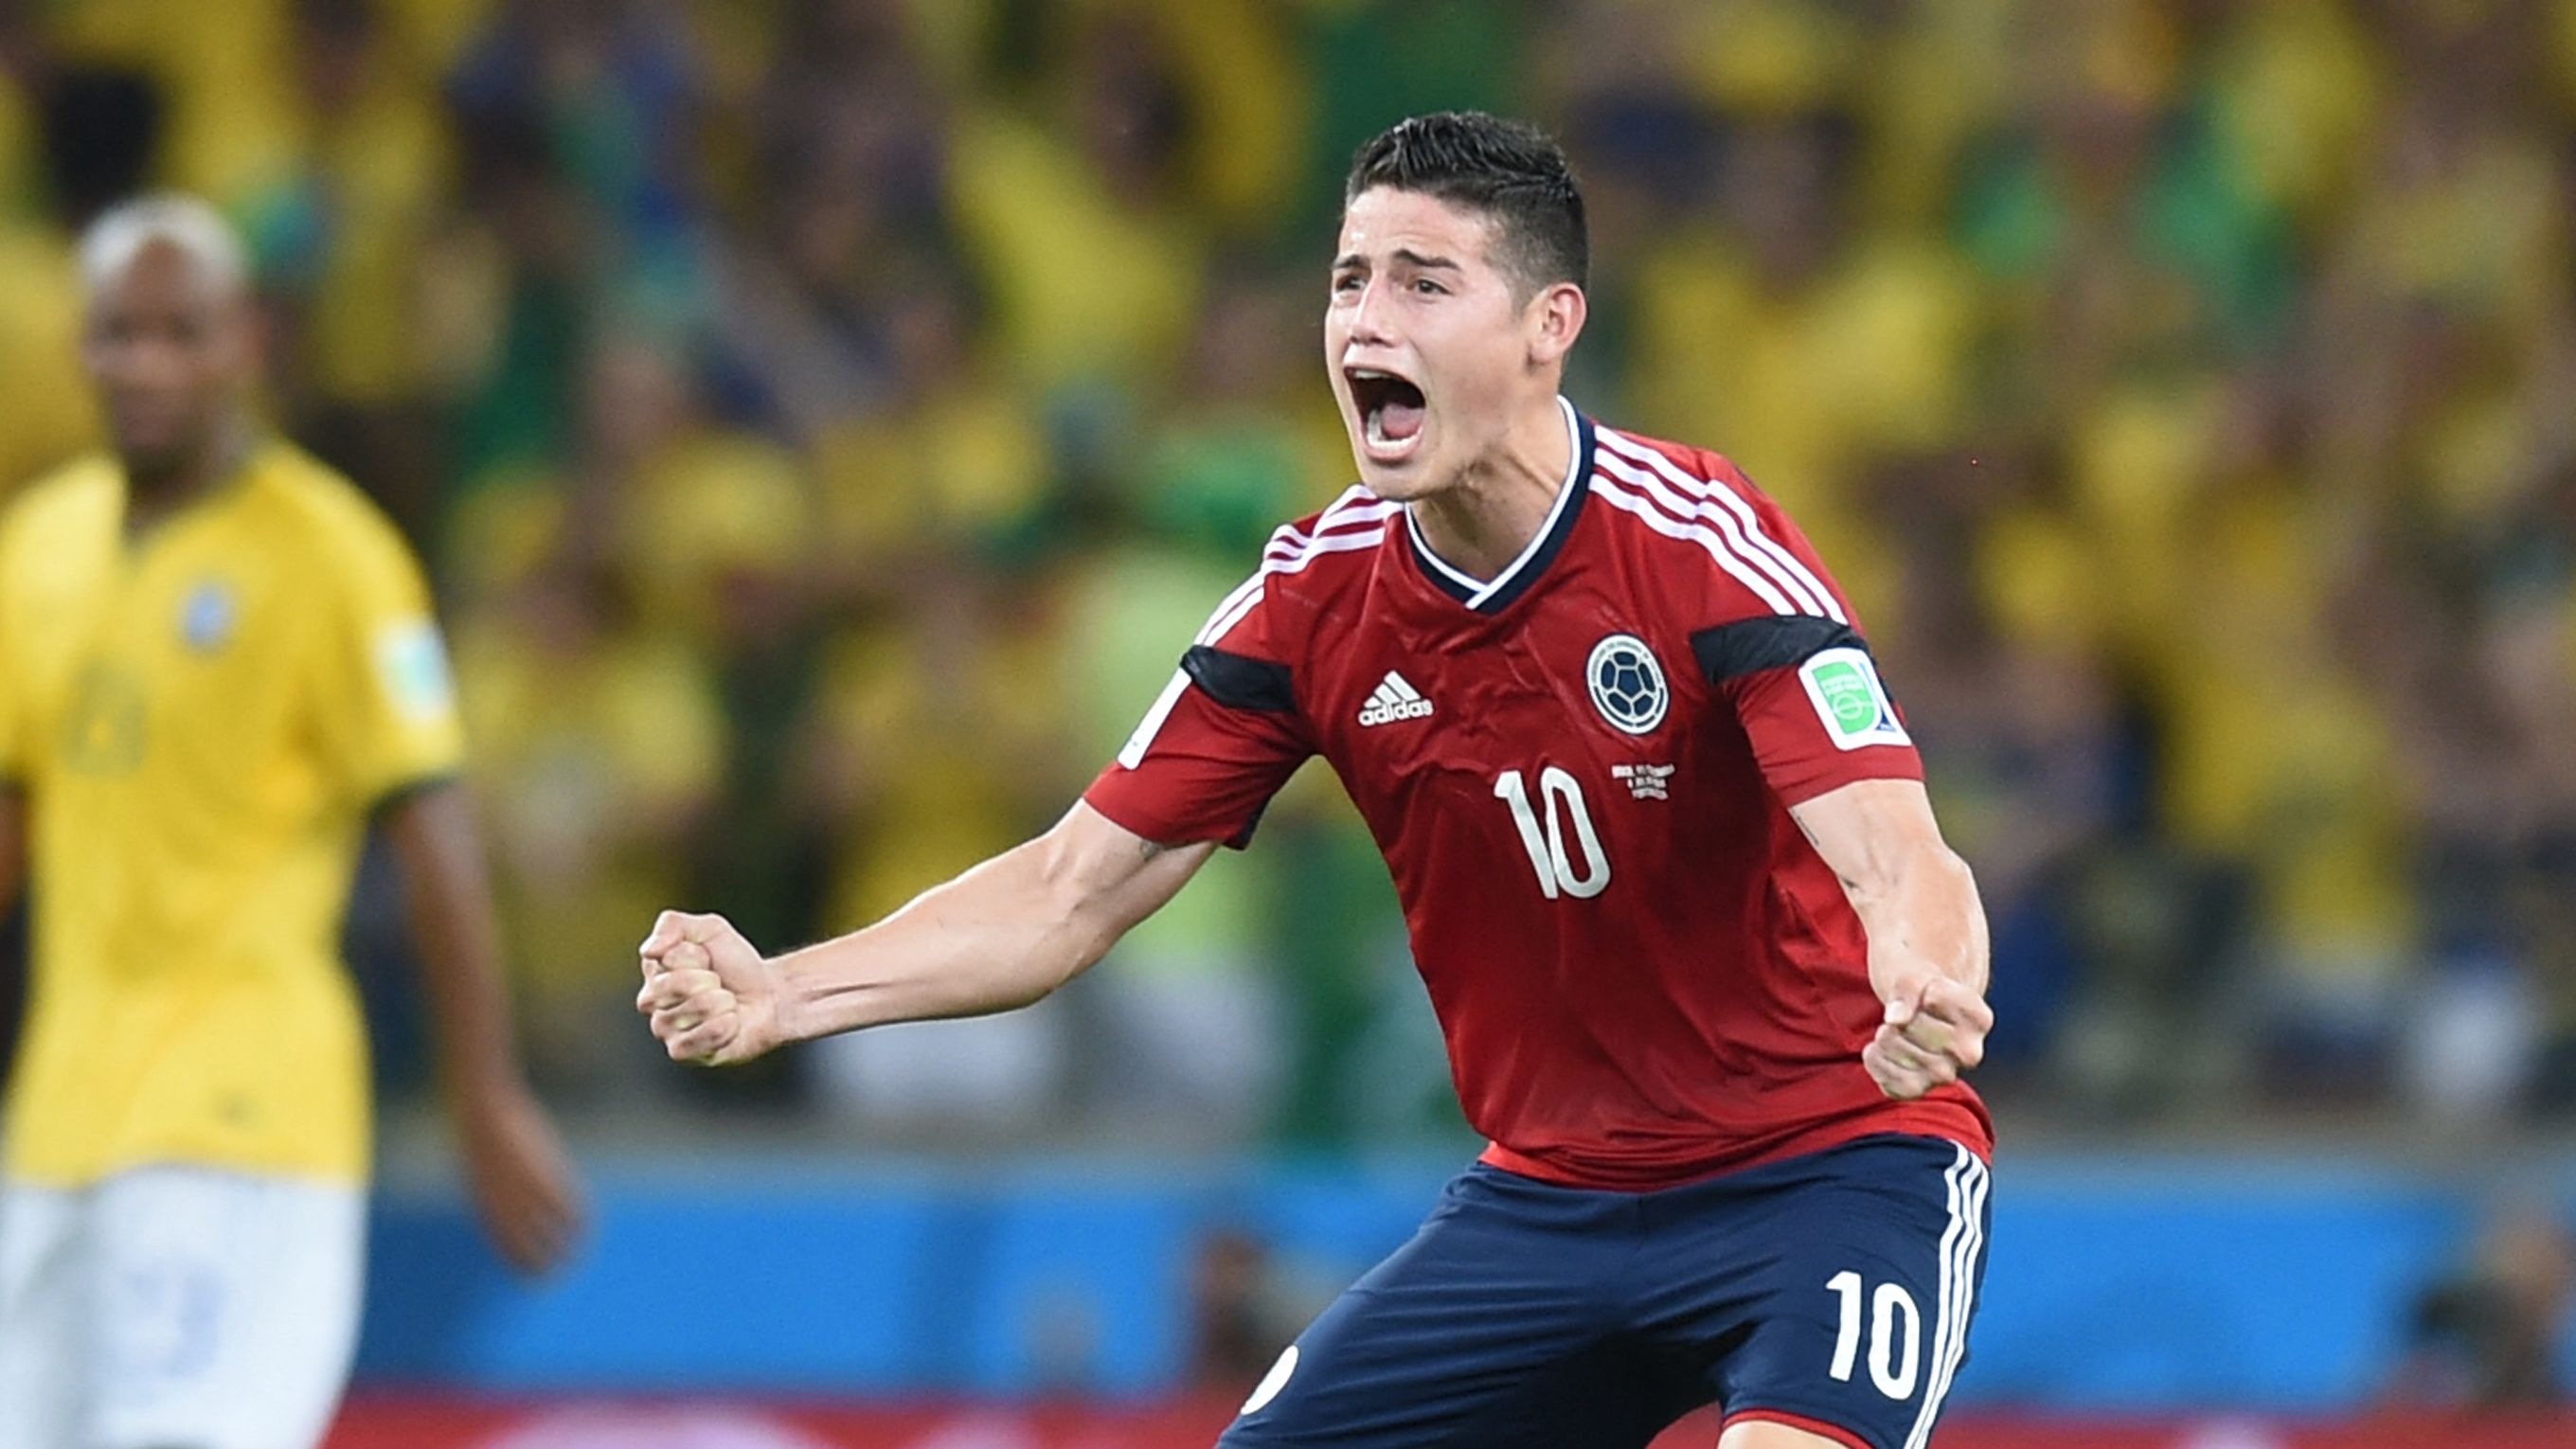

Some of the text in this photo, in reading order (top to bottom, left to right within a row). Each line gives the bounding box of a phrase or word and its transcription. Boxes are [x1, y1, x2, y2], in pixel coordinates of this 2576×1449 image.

[1358, 699, 1433, 726] adidas
[1494, 767, 1611, 899] 10
[1826, 1271, 1920, 1400] 10
